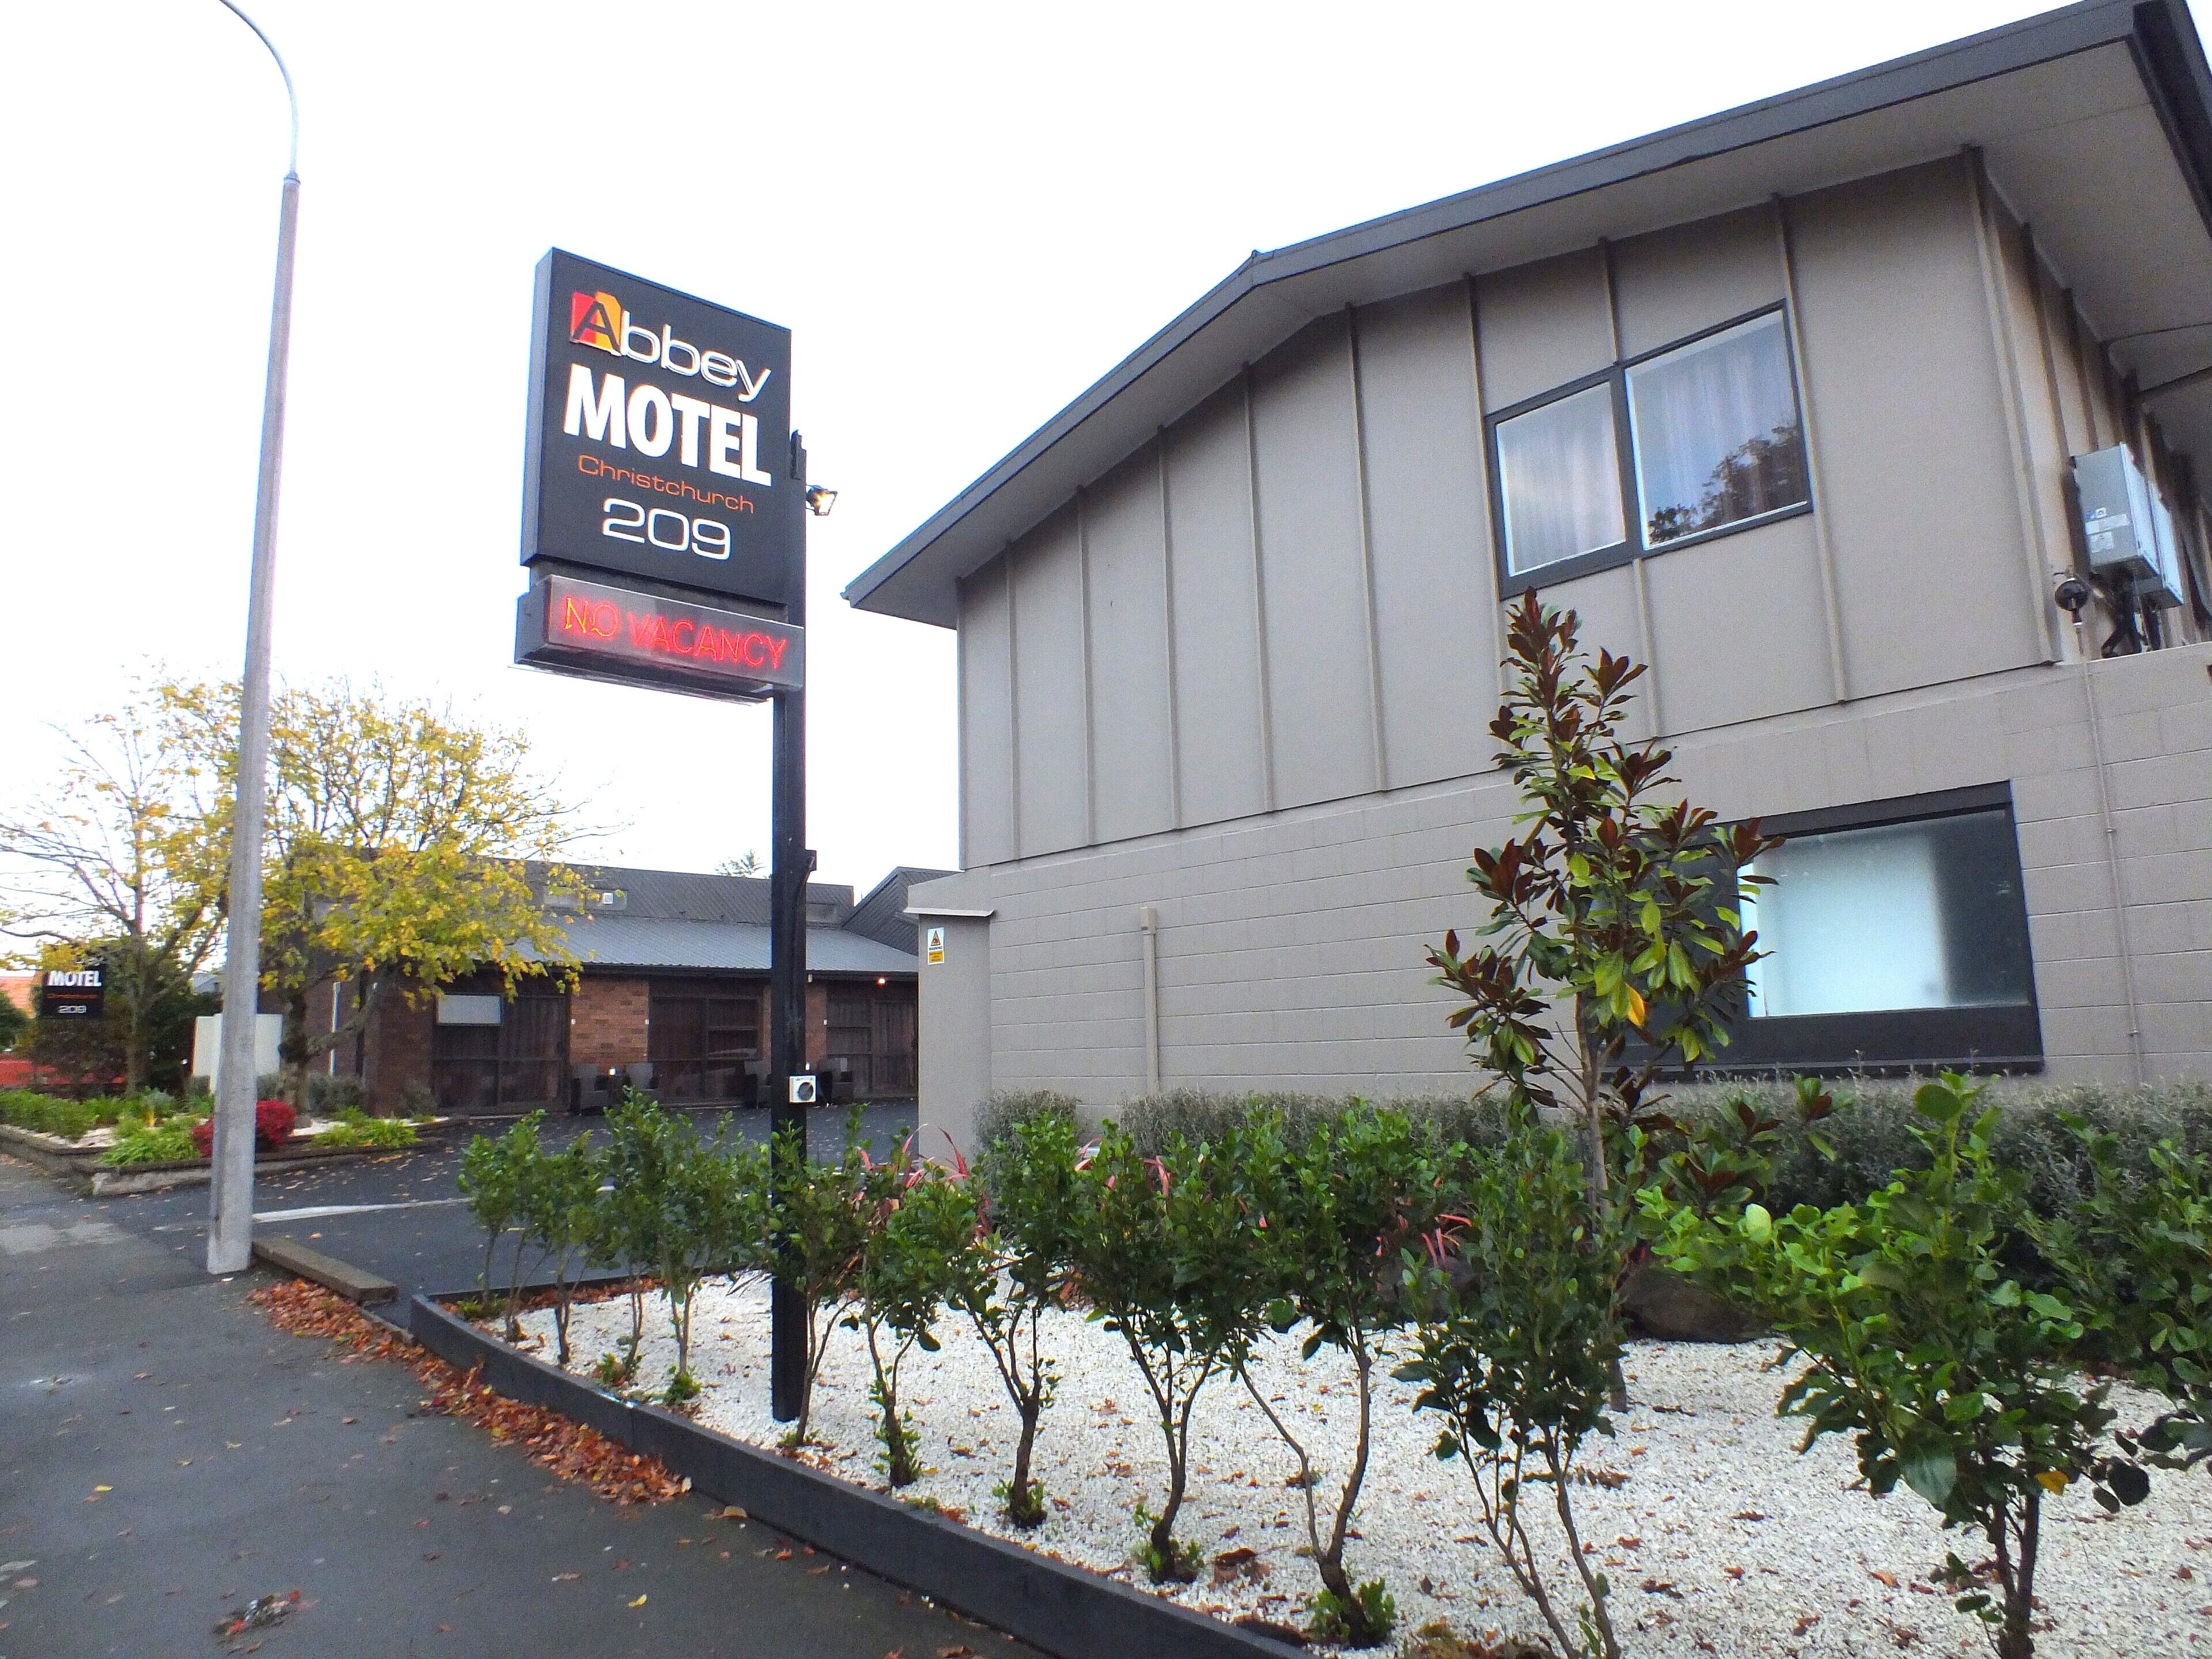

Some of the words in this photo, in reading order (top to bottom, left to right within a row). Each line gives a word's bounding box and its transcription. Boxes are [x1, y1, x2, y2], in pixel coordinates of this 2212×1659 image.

[570, 291, 771, 402] Abbey
[563, 362, 772, 487] MOTEL
[578, 454, 755, 514] Christchurch
[603, 497, 732, 560] 209
[563, 596, 620, 638] NO
[627, 614, 787, 669] VACANCY
[48, 970, 102, 986] MOTEL
[58, 1005, 86, 1013] 209
